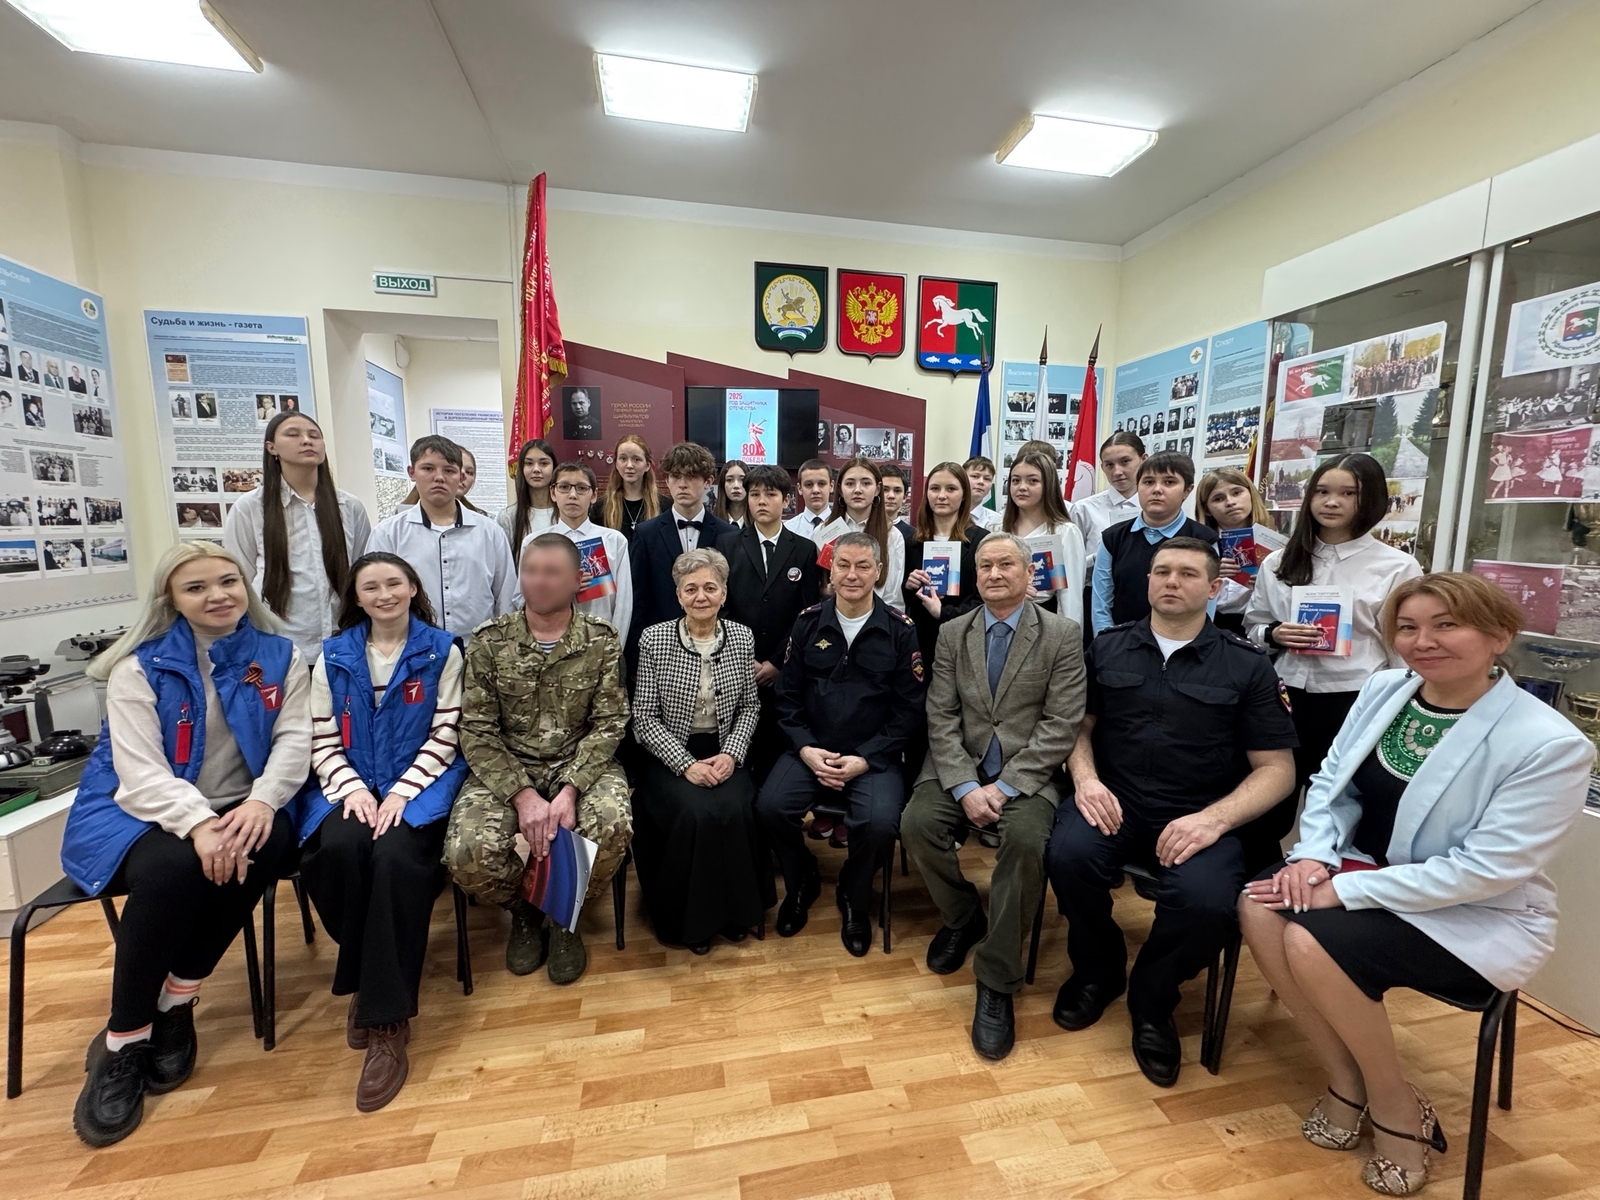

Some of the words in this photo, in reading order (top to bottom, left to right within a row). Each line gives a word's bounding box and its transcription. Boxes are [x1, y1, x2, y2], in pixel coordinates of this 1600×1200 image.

[379, 278, 428, 290] ВЫХОД
[150, 316, 187, 327] Судьба
[197, 320, 226, 328] жизнь
[1214, 336, 1235, 348] Спорт
[729, 392, 743, 400] 2025
[742, 443, 756, 455] 80
